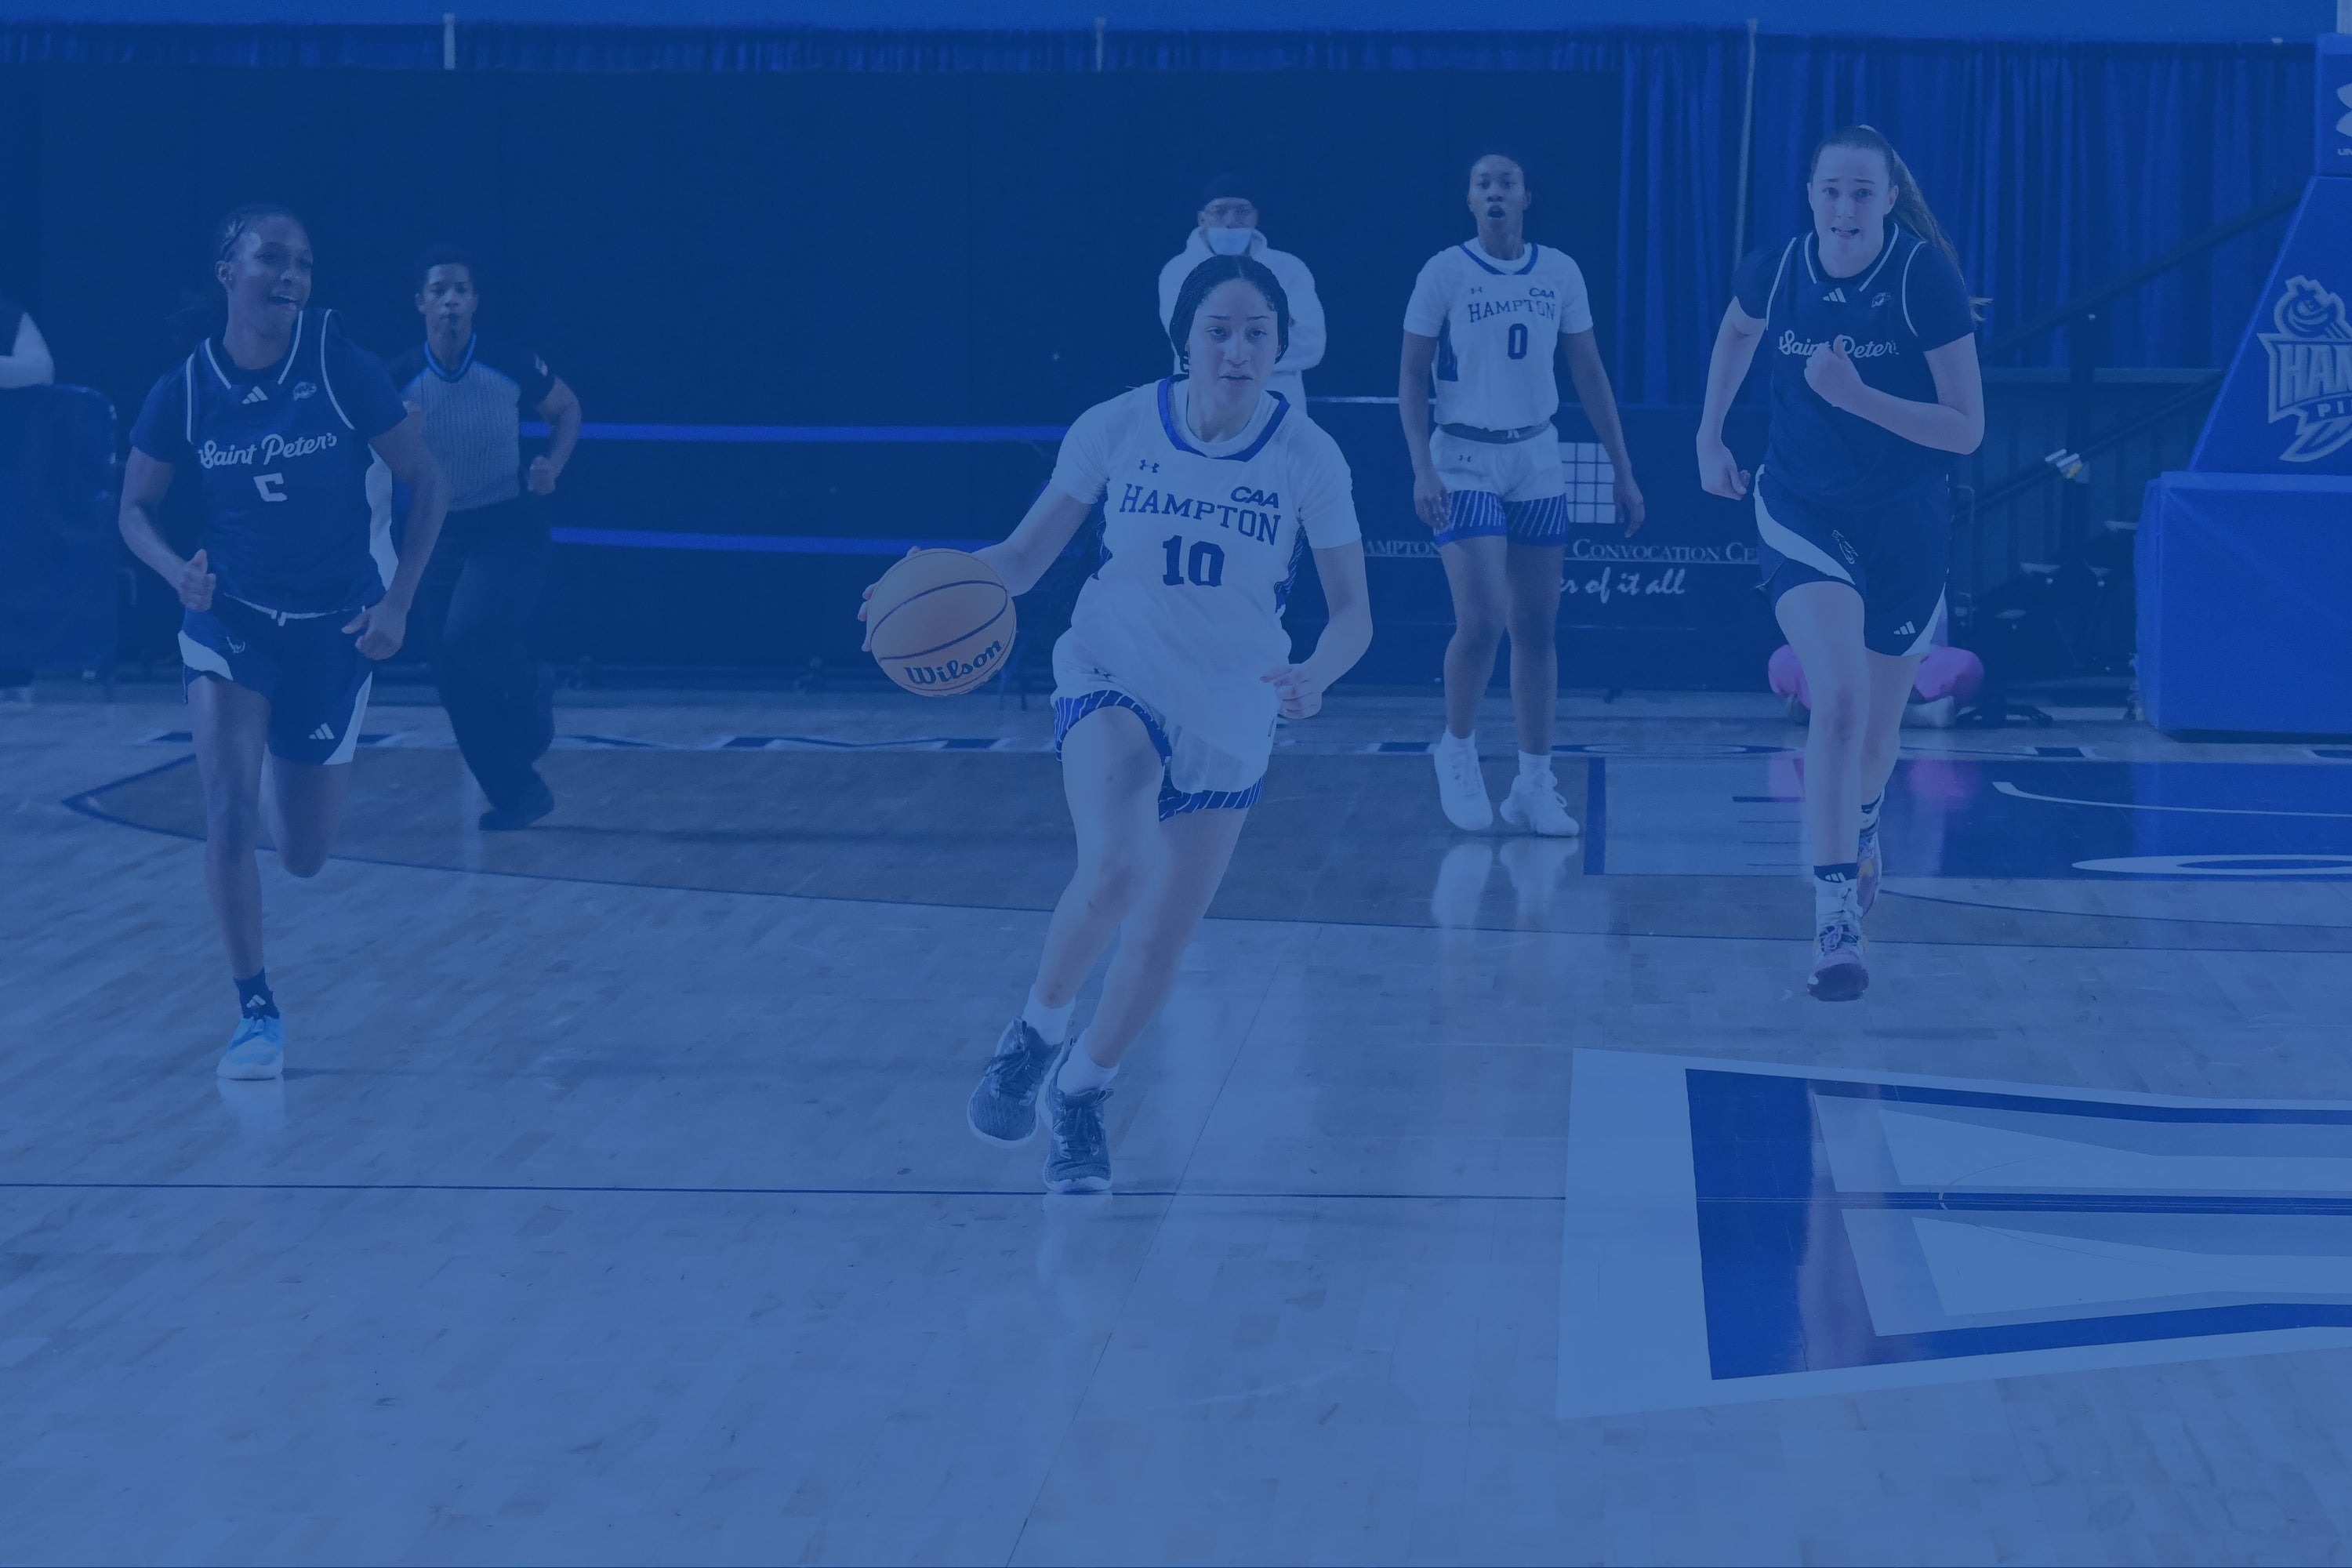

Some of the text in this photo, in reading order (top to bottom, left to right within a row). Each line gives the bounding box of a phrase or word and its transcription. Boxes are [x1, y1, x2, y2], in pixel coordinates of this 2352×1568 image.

[1468, 299, 1555, 323] HAMPTON
[1529, 287, 1555, 299] CAA
[1507, 323, 1528, 360] 0
[198, 432, 338, 469] Saint Peter's
[1119, 483, 1281, 546] HAMPTON
[1230, 486, 1279, 508] CAA
[1162, 535, 1225, 587] 10
[1584, 566, 1611, 604] of
[1617, 572, 1640, 595] it
[1645, 568, 1686, 594] all
[903, 640, 1003, 685] Wilson
